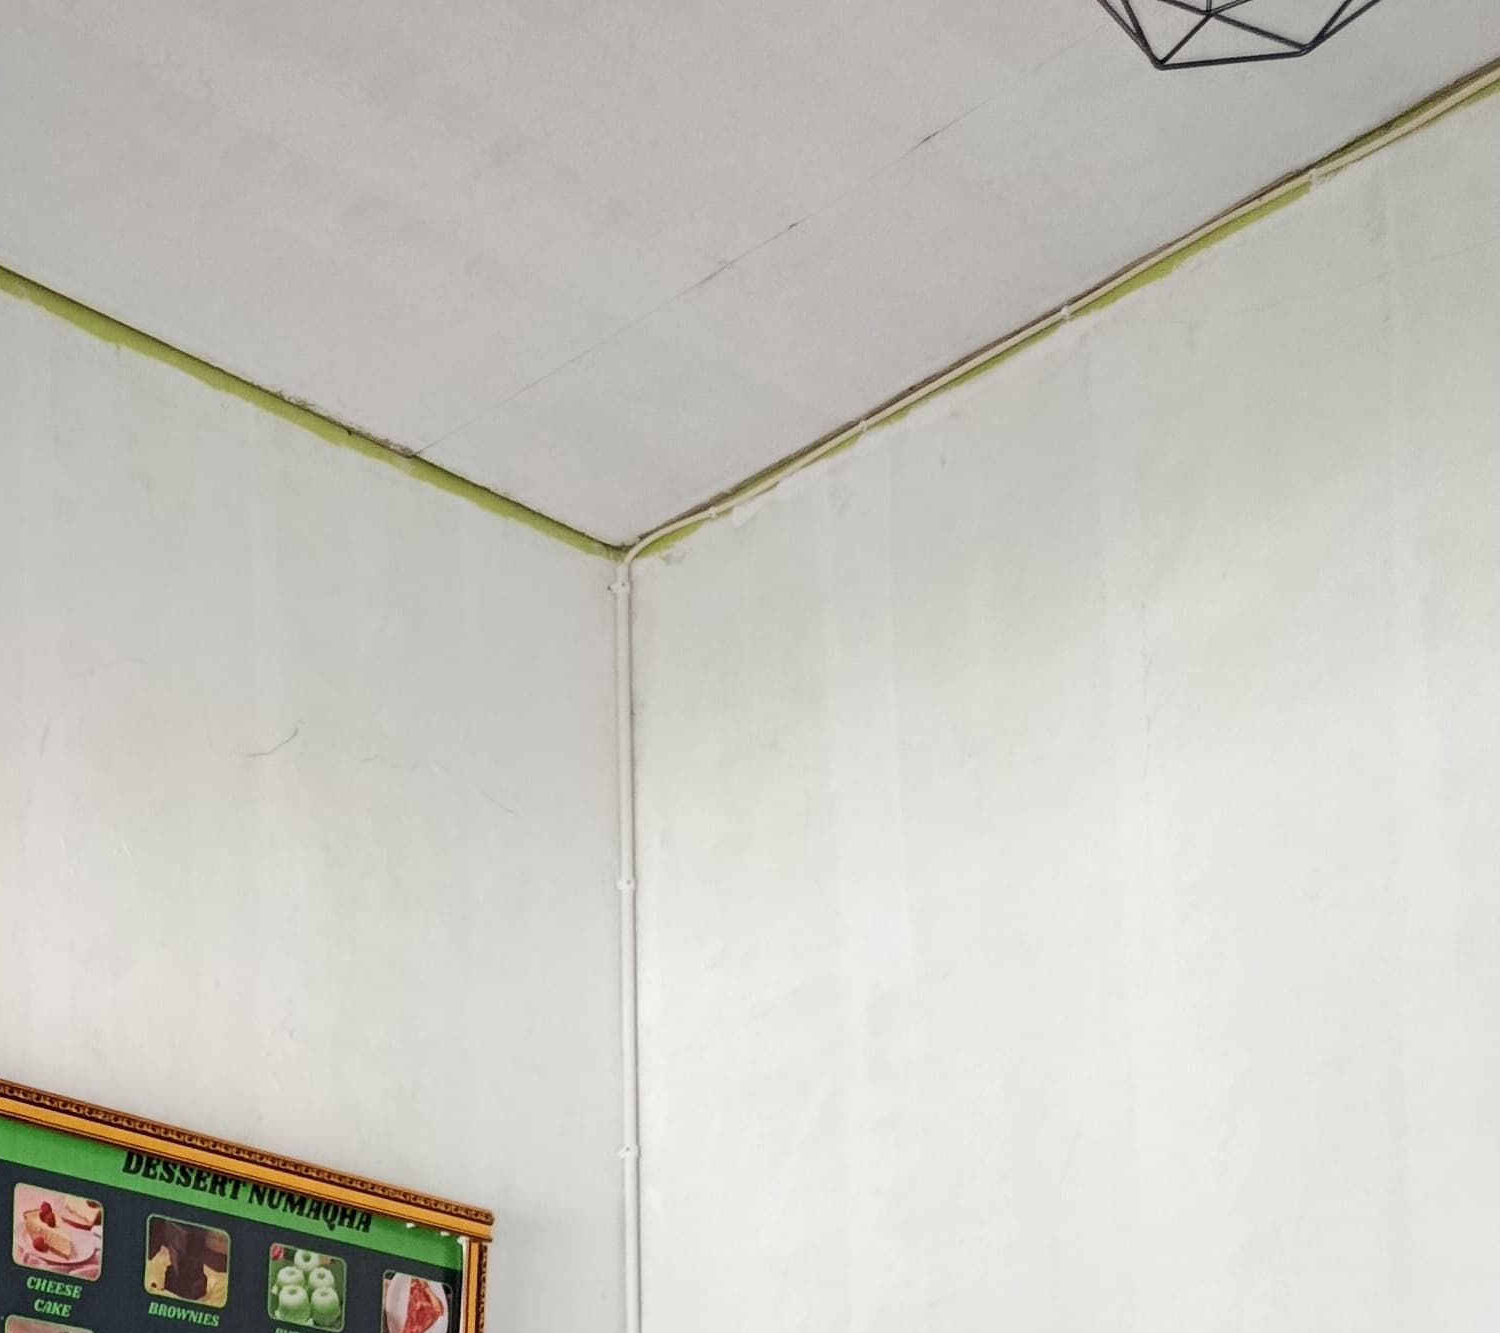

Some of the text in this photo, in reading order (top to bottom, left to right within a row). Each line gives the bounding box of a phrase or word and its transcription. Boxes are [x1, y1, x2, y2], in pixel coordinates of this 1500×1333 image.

[122, 1153, 372, 1233] DESSERT NUMAQHA
[27, 1276, 82, 1298] CHEESE
[34, 1299, 71, 1317] CAKE
[148, 1302, 219, 1326] BROWNIES
